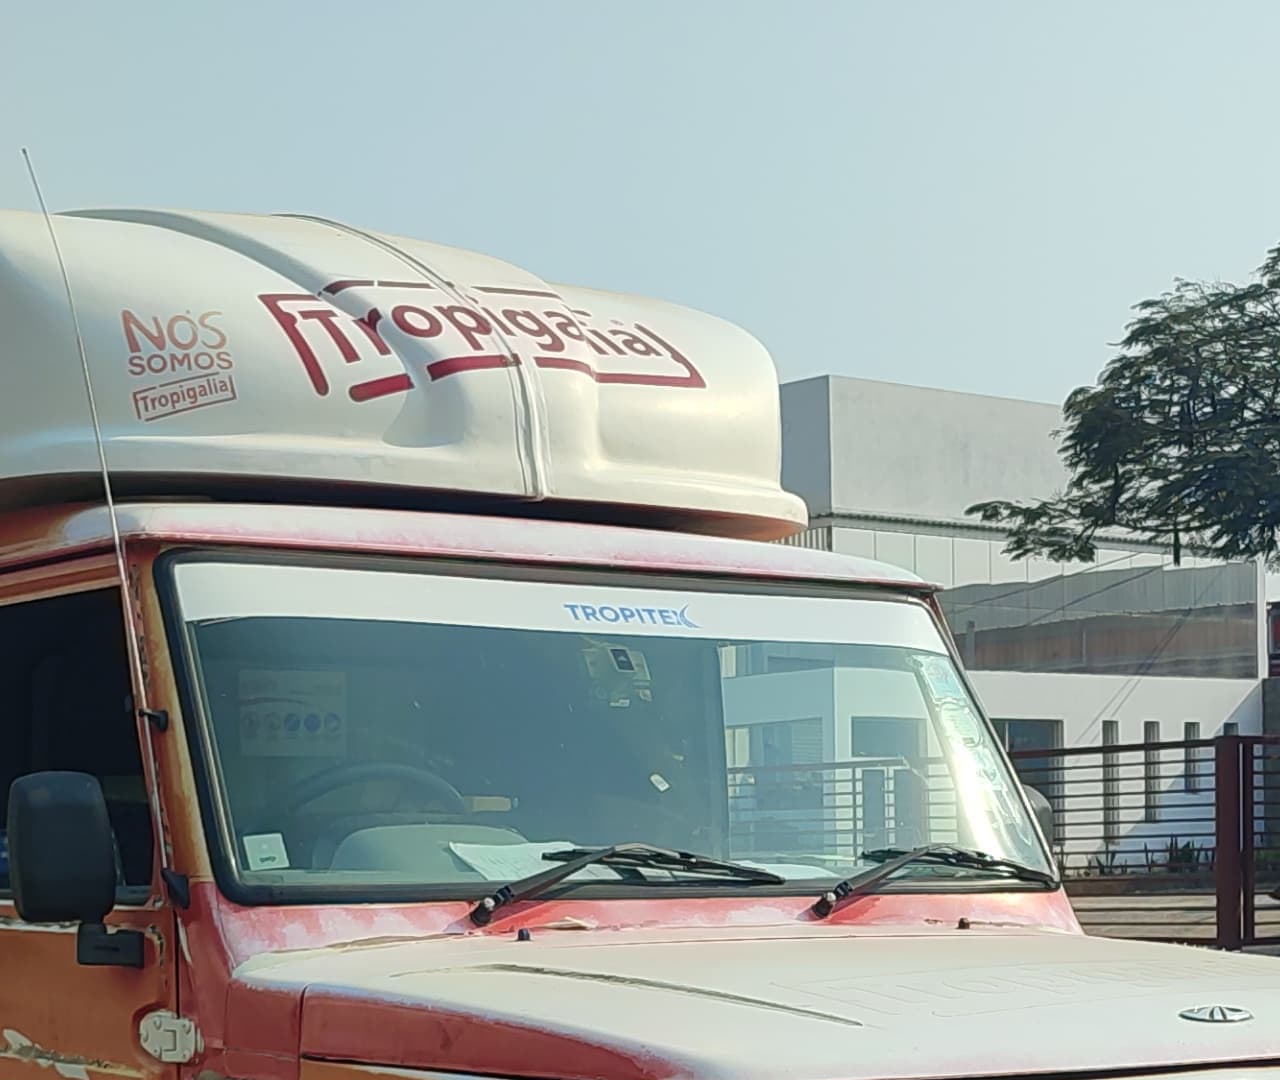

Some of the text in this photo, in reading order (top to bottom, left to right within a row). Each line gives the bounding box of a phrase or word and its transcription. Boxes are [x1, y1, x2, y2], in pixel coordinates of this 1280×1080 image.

[297, 293, 664, 363] Tropigalia
[127, 351, 234, 376] SOMOS
[139, 377, 230, 413] Tropigalia
[563, 602, 703, 629] TROPITEX
